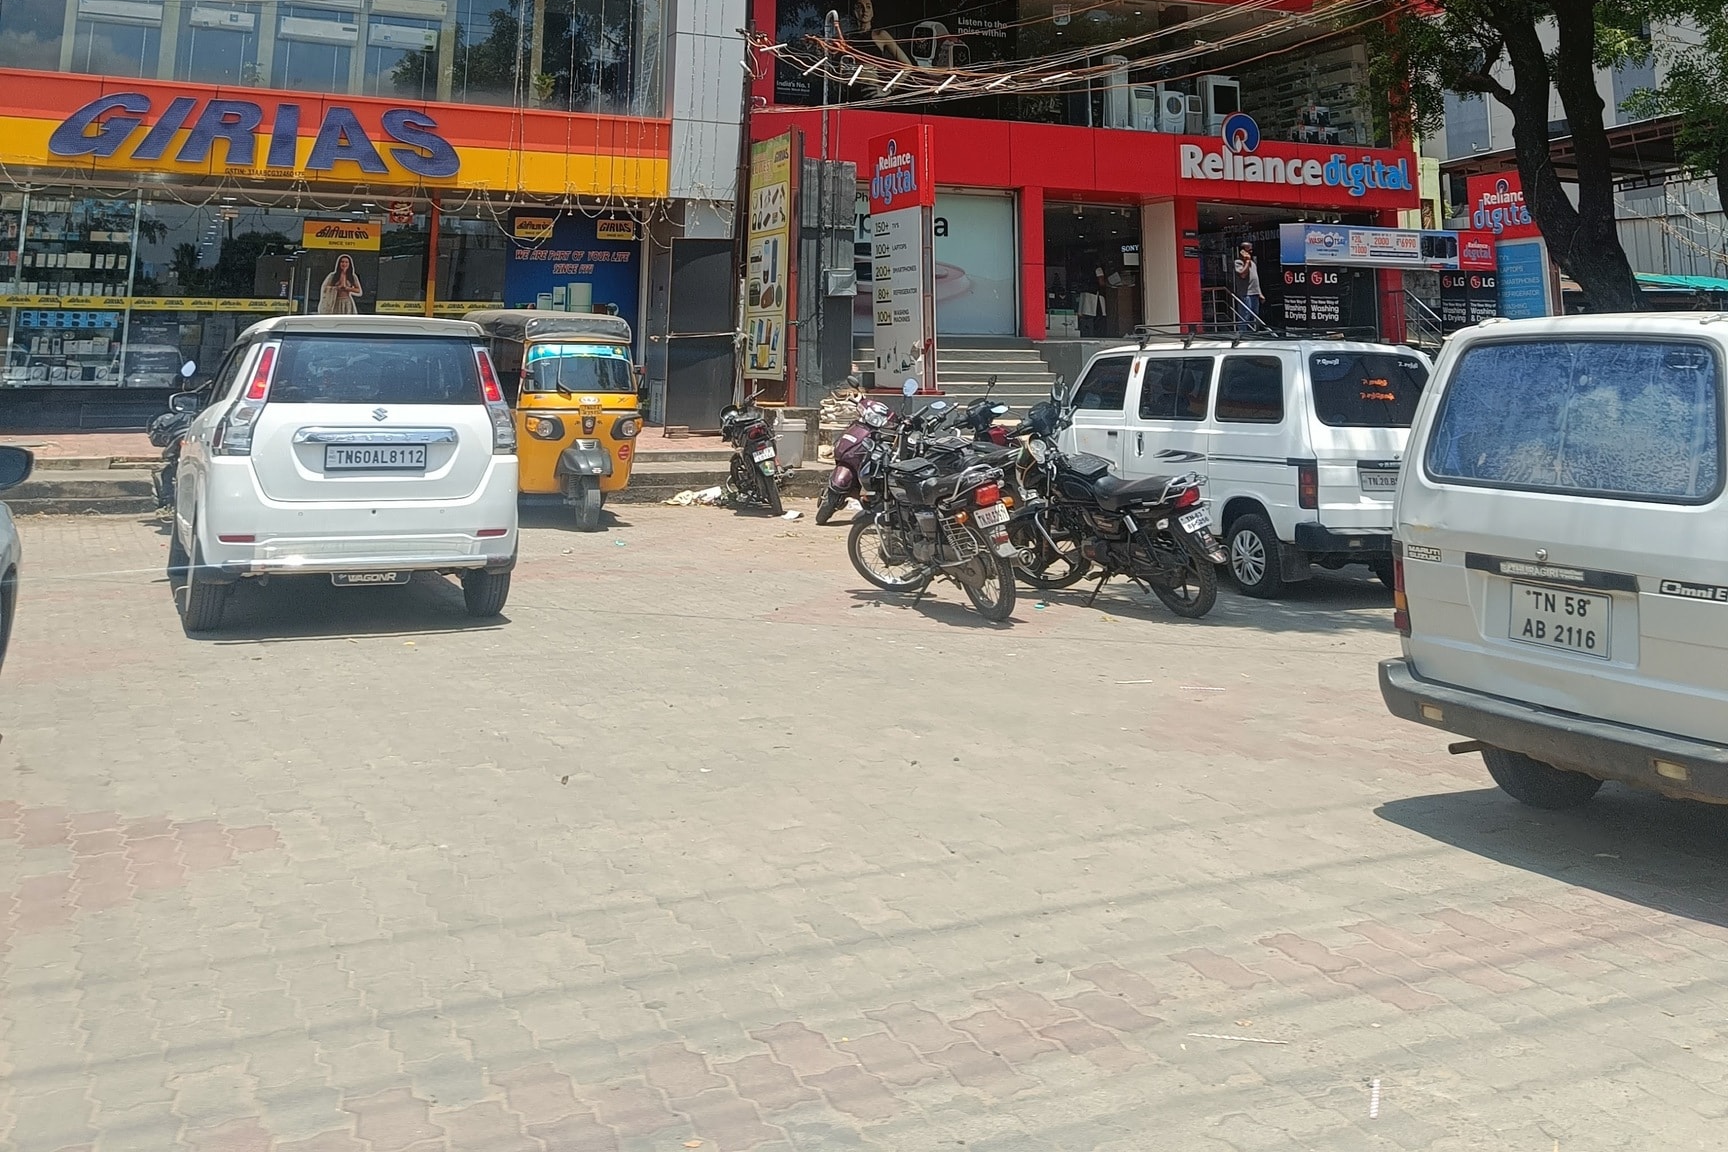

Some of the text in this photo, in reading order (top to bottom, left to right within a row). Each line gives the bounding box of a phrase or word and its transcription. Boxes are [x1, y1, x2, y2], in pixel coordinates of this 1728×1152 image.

[958, 17, 1007, 29] Listen to the
[982, 29, 1006, 38] within
[48, 92, 461, 179] GIRIAS
[879, 152, 911, 171] Reliance
[1180, 144, 1412, 197] Reliance digital
[872, 155, 917, 204] digital
[1483, 190, 1524, 205] Relianc
[1474, 199, 1532, 234] digita
[600, 222, 632, 233] GIRIAS
[875, 221, 889, 232] 150+
[875, 244, 889, 254] 100+
[515, 250, 630, 262] WE ARE PART OF YOUR LIFE
[553, 264, 578, 274] SINCE
[875, 266, 891, 277] 200+
[1295, 272, 1305, 283] LG
[1324, 273, 1338, 283] LG
[1453, 277, 1464, 287] LG
[1482, 277, 1495, 287] LG
[877, 289, 890, 299] 80+
[1284, 304, 1306, 313] Washing
[1311, 305, 1339, 313] Washing
[1442, 307, 1466, 316] Washing
[1470, 308, 1496, 316] Washing
[877, 311, 892, 322] 100+
[1290, 312, 1306, 321] Drying
[1317, 313, 1339, 321] Drying
[1448, 314, 1466, 323] Drying
[336, 450, 423, 464] TN60AL8112
[1408, 545, 1440, 555] MARUTI
[1408, 552, 1440, 562] SUZUKI
[348, 572, 397, 582] WAGONR
[1661, 581, 1727, 600] Omni E
[1532, 591, 1587, 617] TN 58
[1522, 618, 1596, 649] AB 2116
